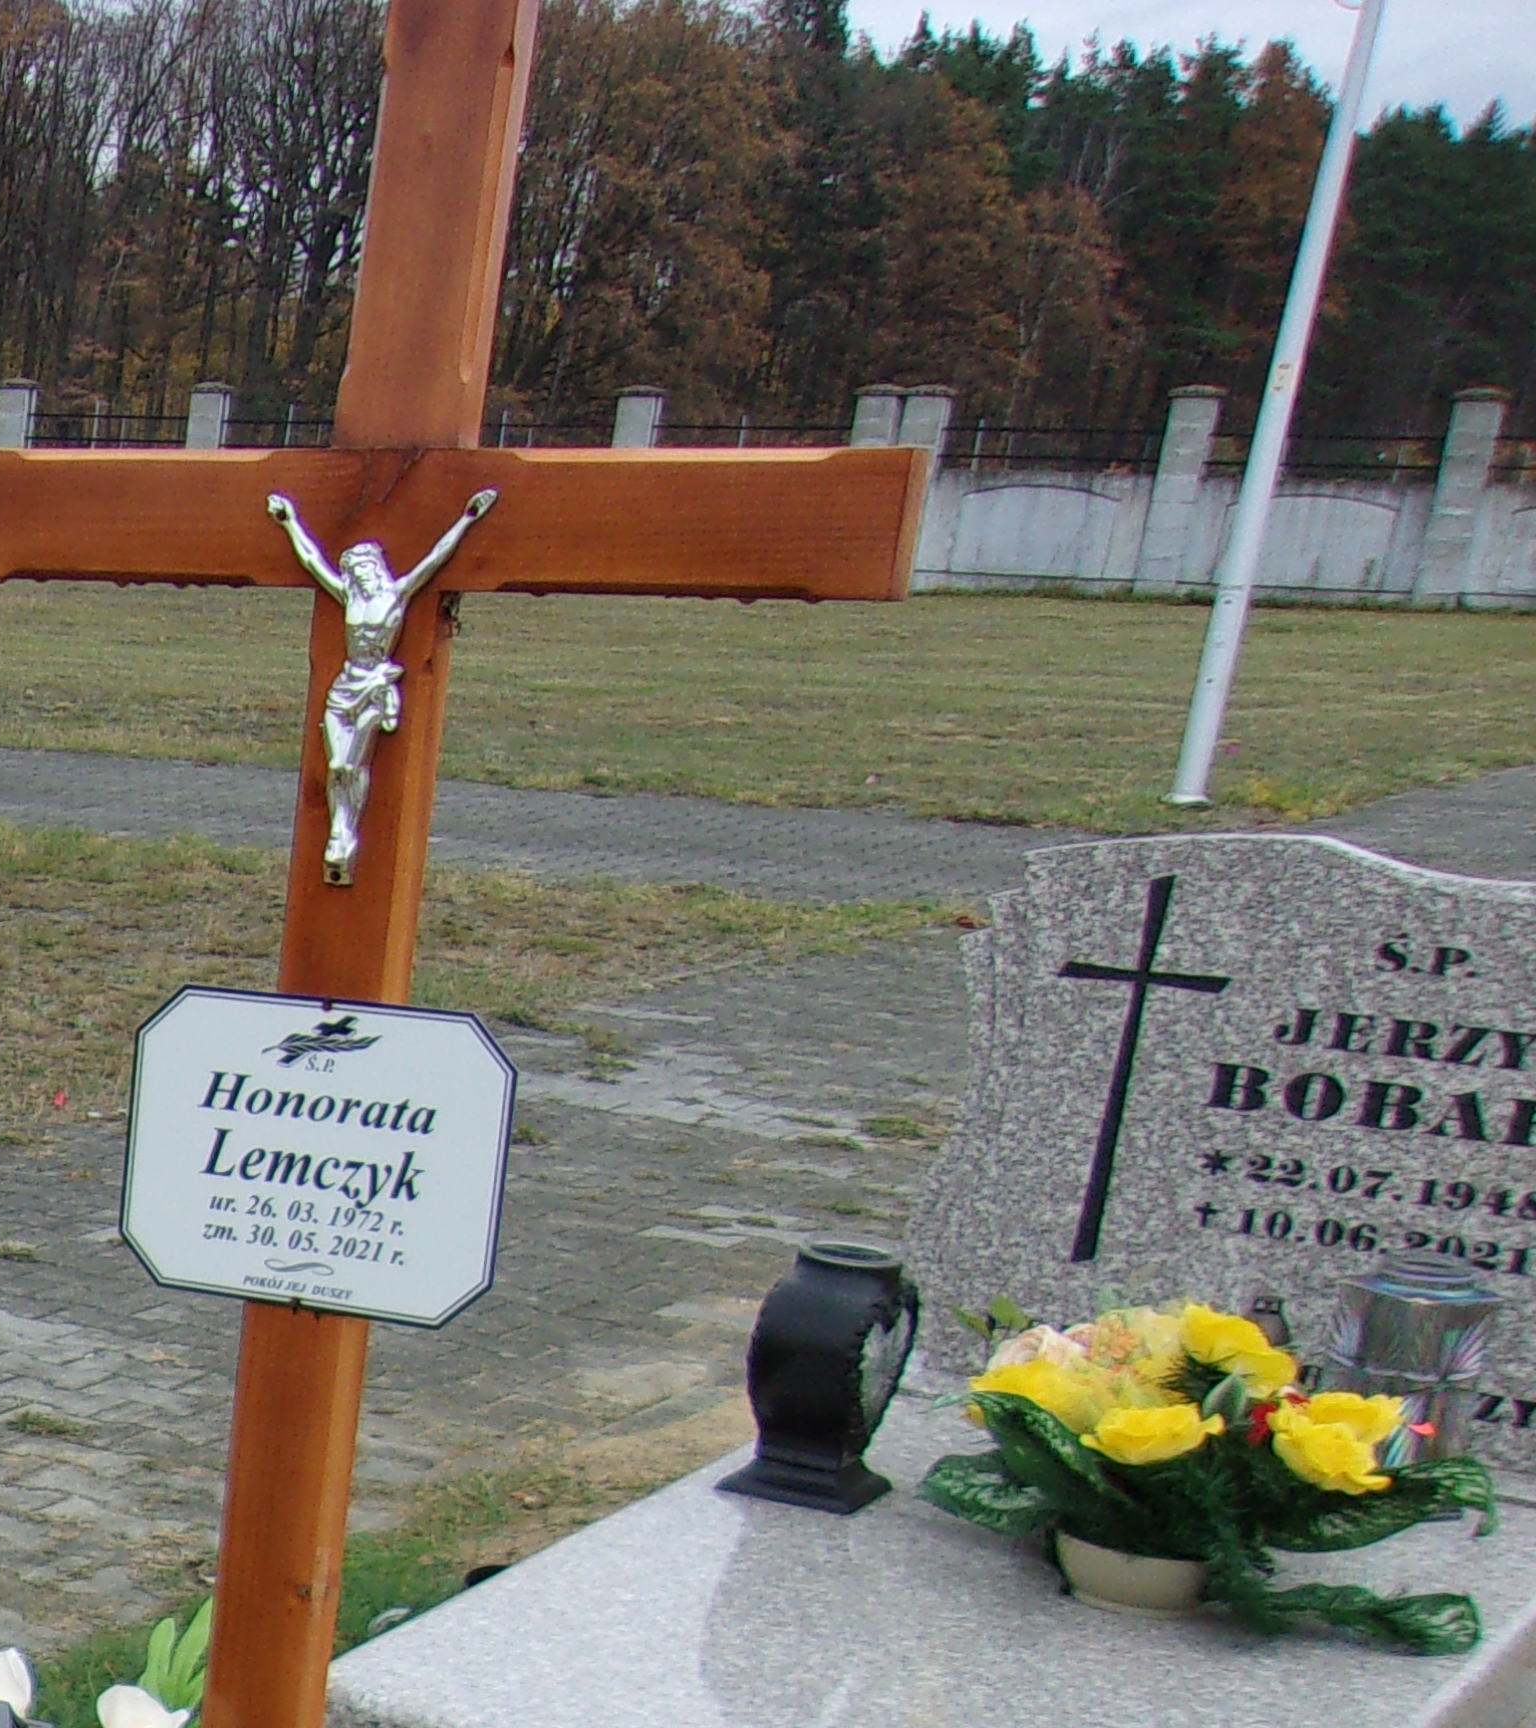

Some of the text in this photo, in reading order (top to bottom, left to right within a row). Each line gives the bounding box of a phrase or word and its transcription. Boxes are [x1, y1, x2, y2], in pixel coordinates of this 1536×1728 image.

[1273, 1008, 1536, 1071] JERZY
[198, 1071, 437, 1135] Honorata
[199, 1128, 426, 1209] Lemczyk
[209, 1195, 404, 1236] ur. 26. 03. 1972 r.
[203, 1223, 405, 1266] zm. 30. 05. 2021 r.
[242, 1275, 353, 1300] POKÓJ JEJ DUSZY
